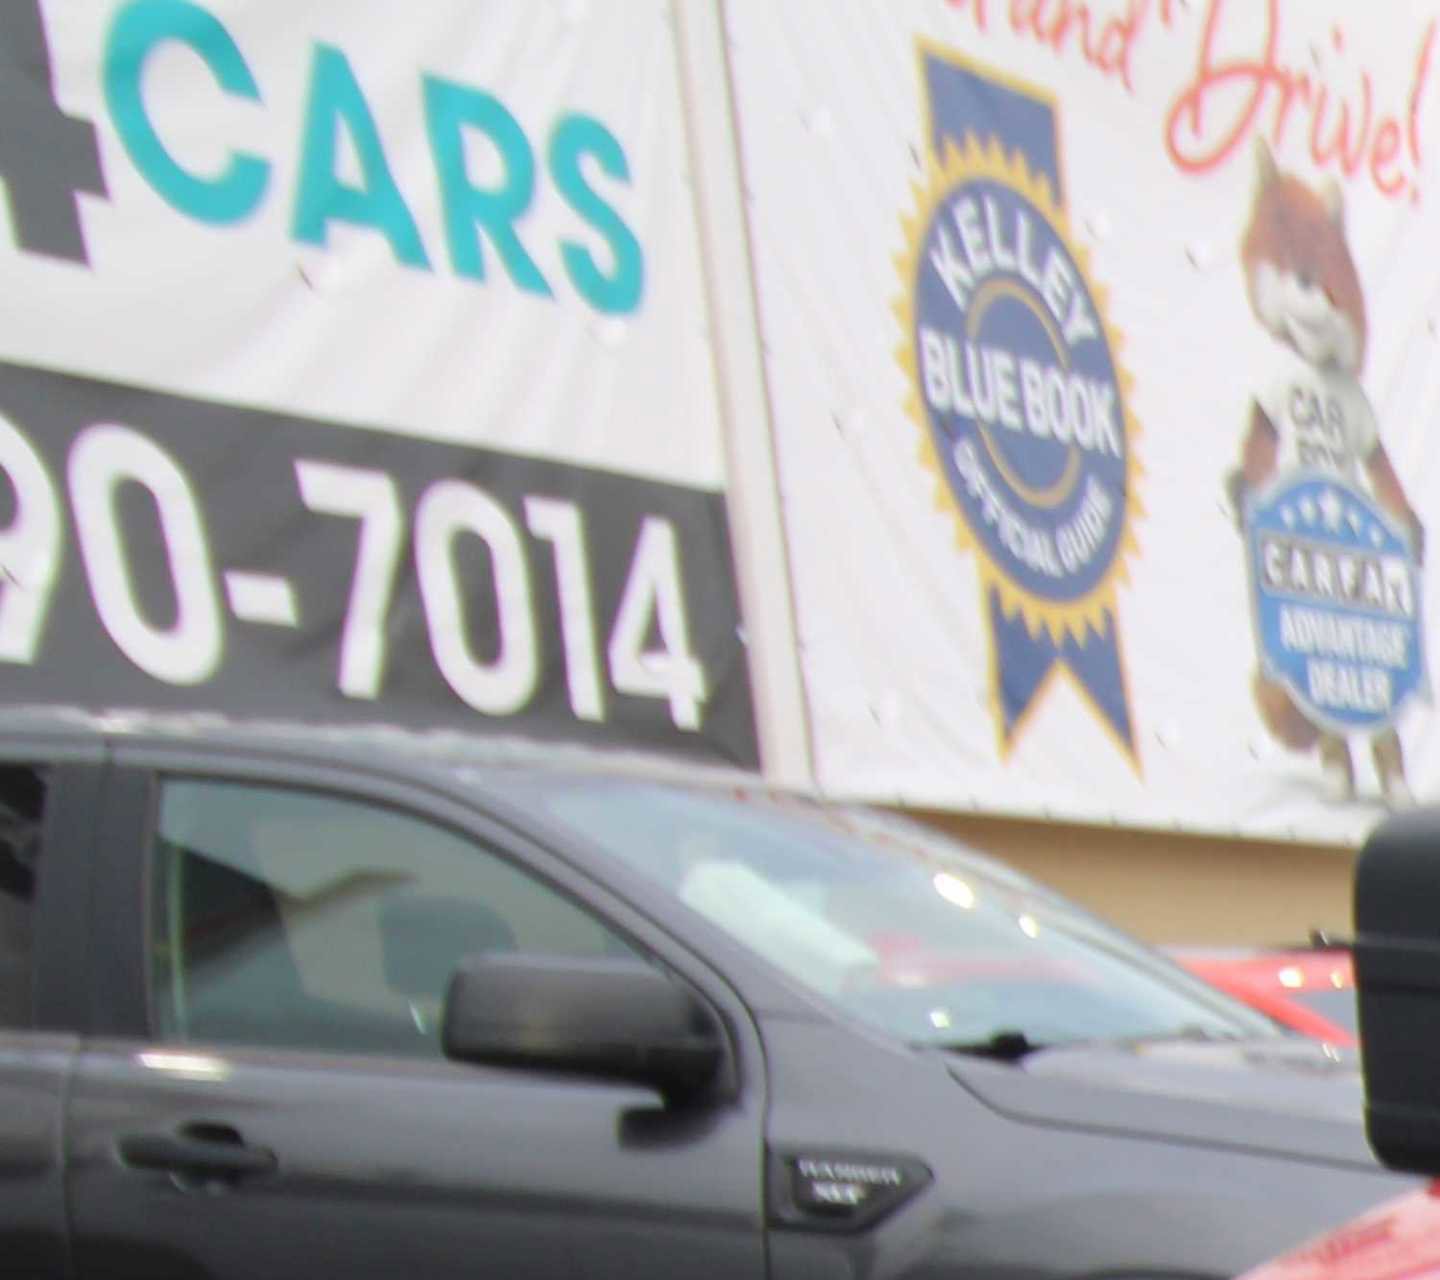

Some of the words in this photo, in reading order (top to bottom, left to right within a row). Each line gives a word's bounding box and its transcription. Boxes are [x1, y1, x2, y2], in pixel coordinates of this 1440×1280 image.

[931, 194, 1100, 347] KELLEY
[920, 325, 1023, 433] BLUE
[1020, 355, 1122, 460] BOOK
[1306, 656, 1394, 716] DEALER
